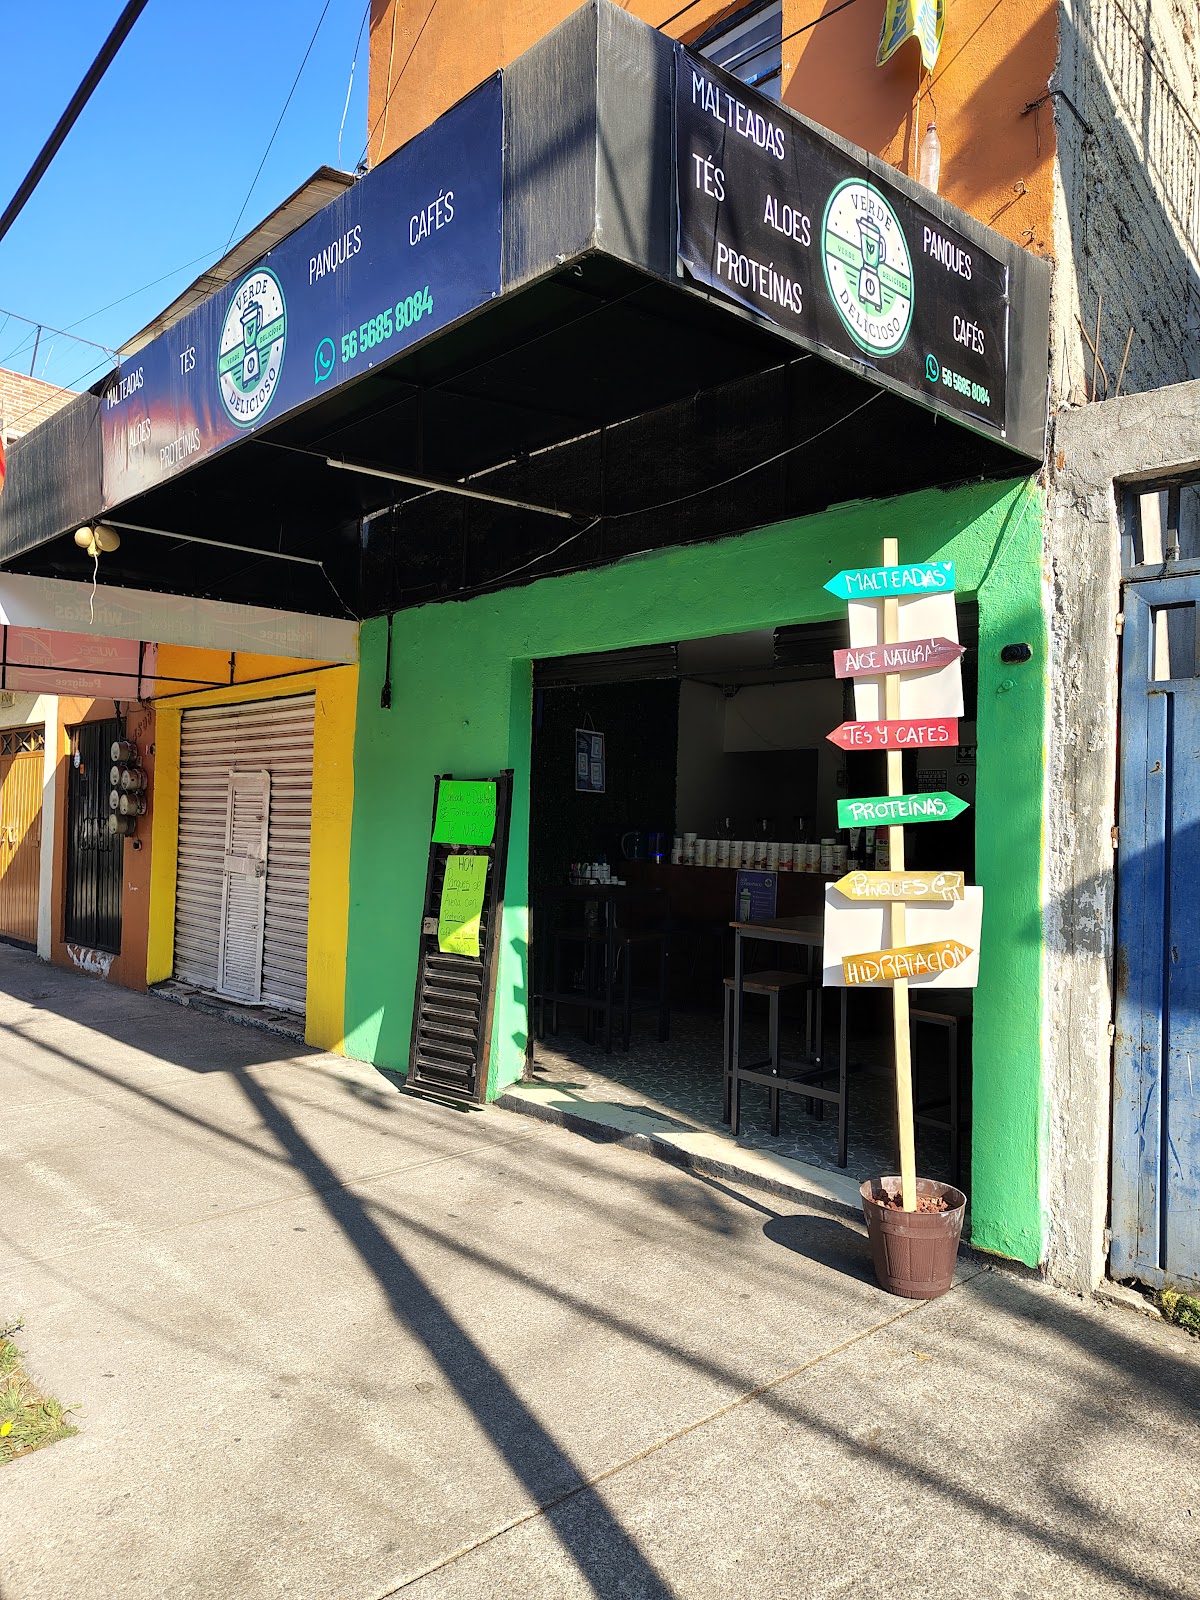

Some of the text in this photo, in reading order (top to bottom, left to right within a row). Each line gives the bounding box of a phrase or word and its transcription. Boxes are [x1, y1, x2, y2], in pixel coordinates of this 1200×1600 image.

[692, 70, 786, 161] MALTEADAS
[692, 152, 726, 203] TÉS
[409, 188, 455, 247] CAFÉS
[763, 193, 812, 247] ALOES
[851, 193, 892, 232] VERDE
[309, 224, 363, 286] PANQUES
[837, 245, 908, 291] VERDE DELICIOSO
[923, 225, 973, 281] PANQUES
[236, 279, 268, 312] VERDE
[716, 241, 803, 315] PROTEÍNAS
[341, 285, 434, 364] 56 5685 8084
[840, 288, 901, 340] DELICIOSO
[953, 315, 985, 355] CAFÉS
[180, 344, 196, 376] TÉS
[227, 324, 282, 366] VERDE DELICIOSO
[106, 366, 144, 410] MALTEADAS
[229, 366, 276, 414] DELICIOSO
[941, 366, 991, 408] 56 5685 8084
[128, 417, 151, 450] ALOES
[160, 427, 201, 471] PROTEÍNAS
[845, 567, 946, 594] MALTEADAS
[883, 638, 941, 668] NATURAL
[895, 725, 950, 744] CAFES
[847, 795, 948, 822] PROTEÍNAS
[847, 943, 967, 985] HIDRATACIÓN
